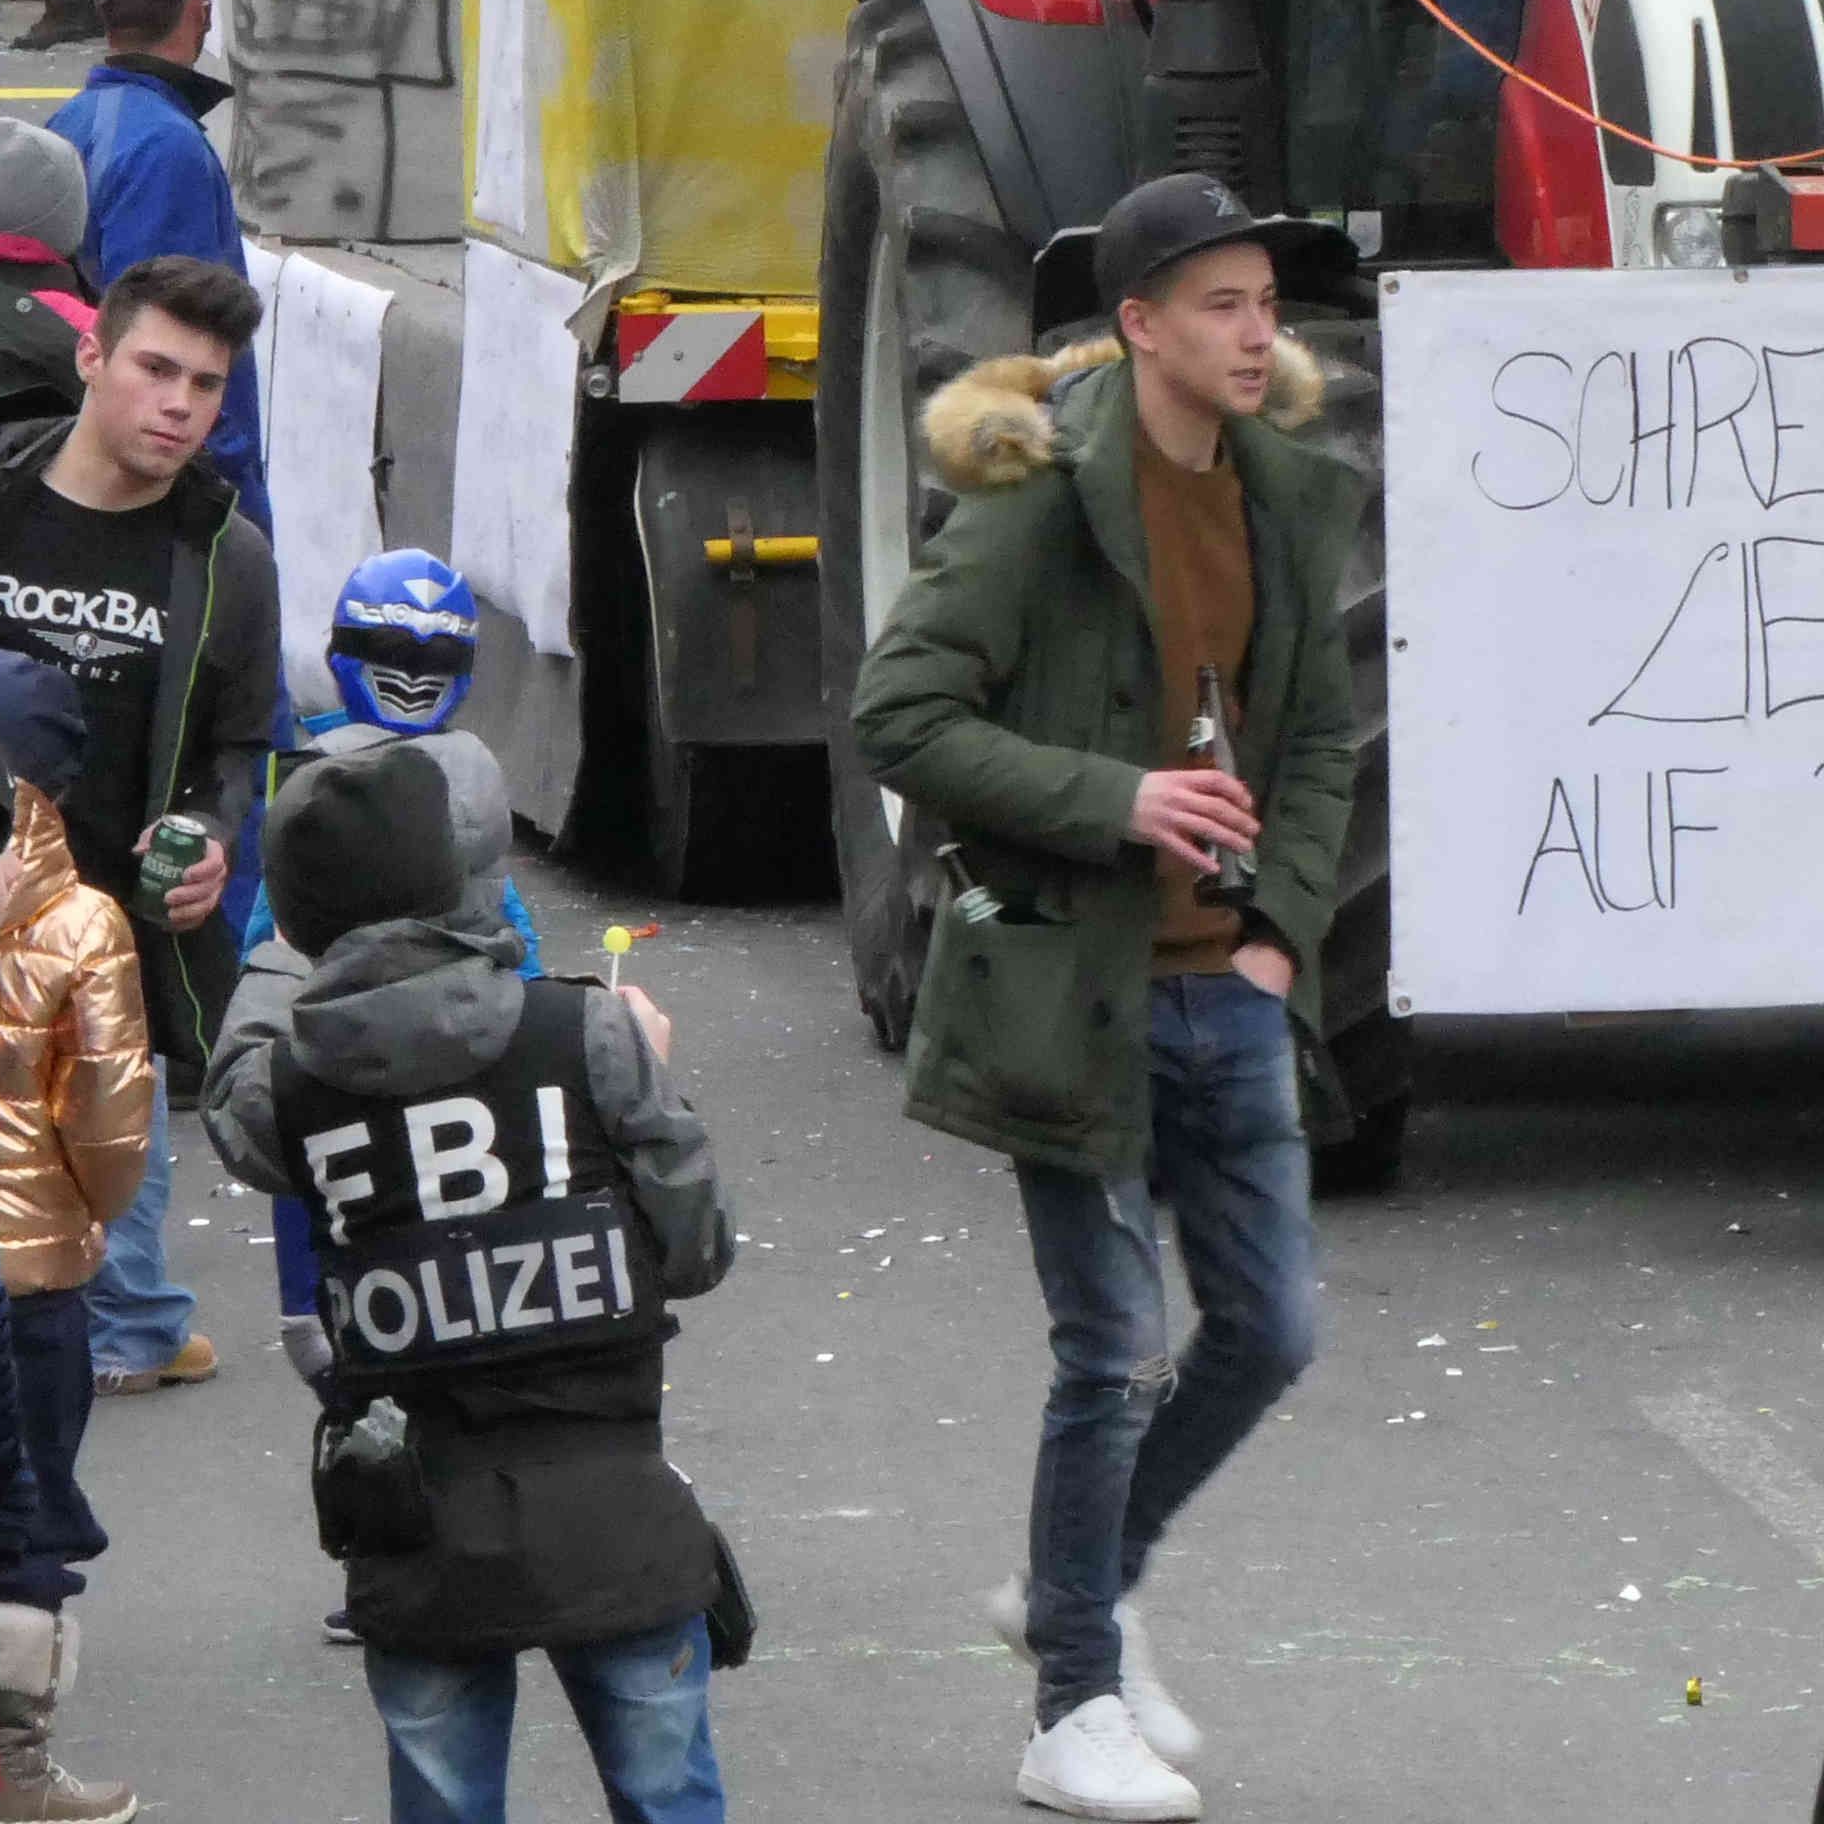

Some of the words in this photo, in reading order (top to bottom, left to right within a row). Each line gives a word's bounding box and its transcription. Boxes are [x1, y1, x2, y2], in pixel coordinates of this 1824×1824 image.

[1516, 765, 1731, 916] AUF
[304, 1085, 572, 1247] FBI
[327, 1226, 635, 1354] POLIZEI
